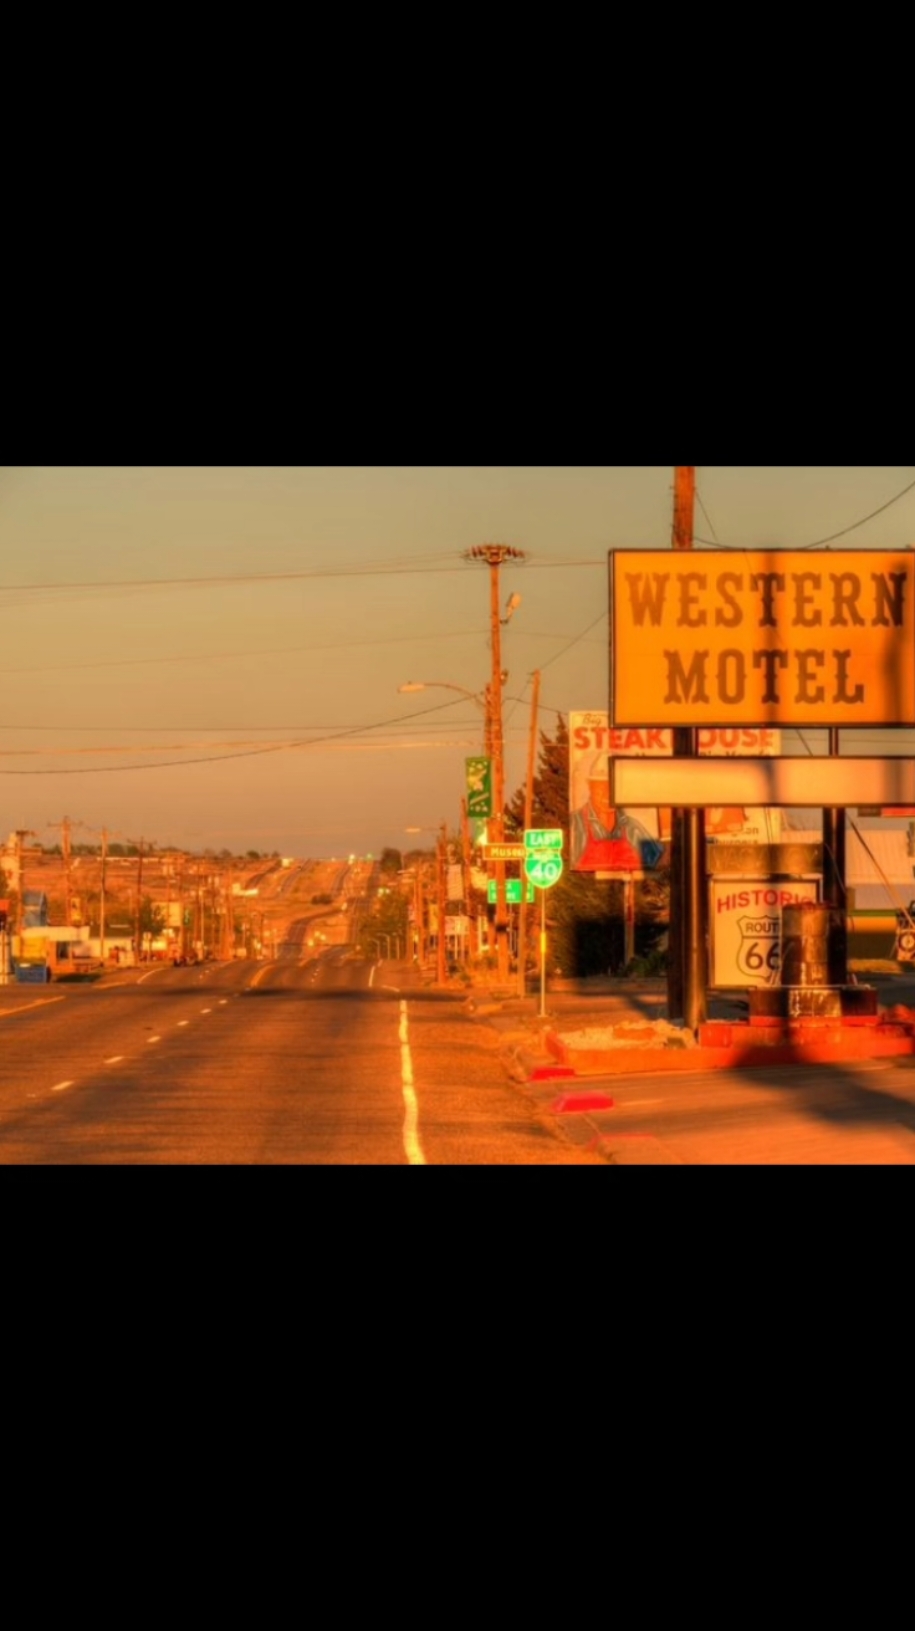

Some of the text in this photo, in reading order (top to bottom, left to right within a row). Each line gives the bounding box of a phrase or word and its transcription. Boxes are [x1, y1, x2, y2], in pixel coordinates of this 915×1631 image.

[624, 571, 907, 628] WESTERN
[663, 649, 865, 704] MOTEL
[573, 726, 774, 750] STEAK OUSE
[529, 832, 557, 847] EAST
[490, 847, 526, 858] Museu
[530, 861, 558, 881] 40
[745, 921, 780, 933] ROUT
[745, 941, 780, 971] 66
